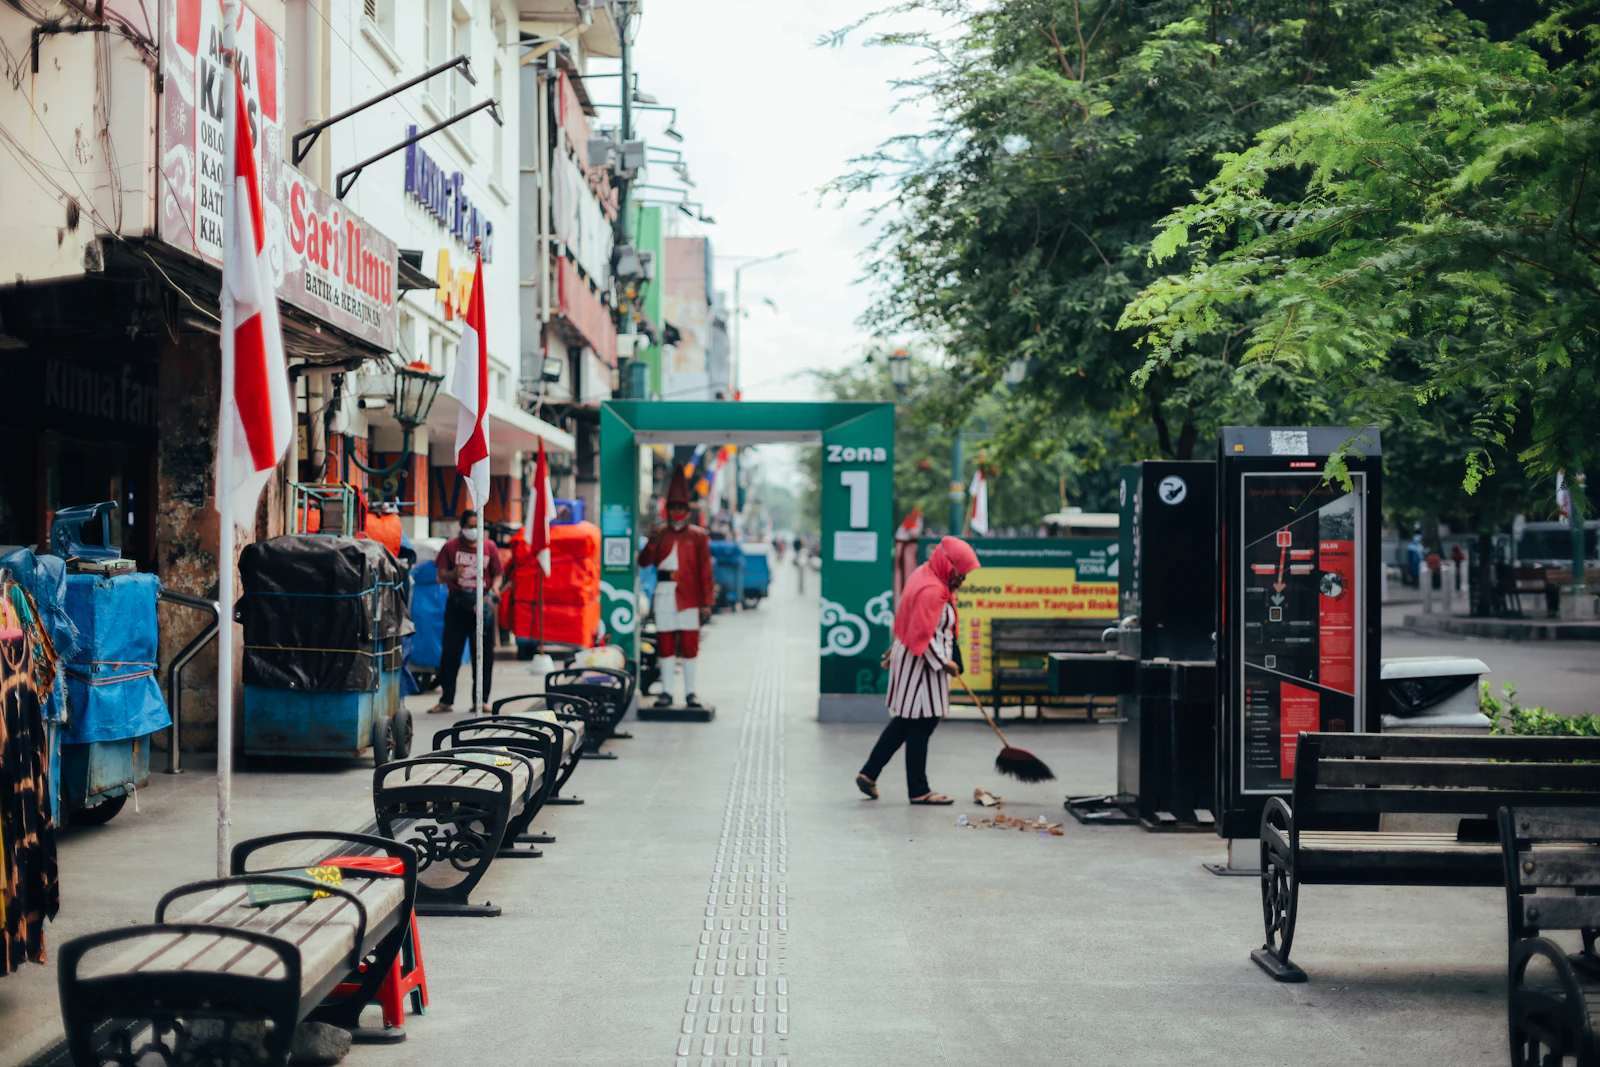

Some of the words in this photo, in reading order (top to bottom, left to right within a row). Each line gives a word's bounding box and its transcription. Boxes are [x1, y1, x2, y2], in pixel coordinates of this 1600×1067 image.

[201, 120, 224, 155] OBLO
[201, 151, 224, 186] KAO
[201, 183, 224, 218] BATI
[201, 215, 224, 249] KHA
[290, 181, 339, 277] Sari
[346, 219, 392, 307] Ilmu
[305, 272, 333, 303] BATIK
[334, 287, 339, 305] &
[341, 290, 381, 328] KERAJINAN
[827, 444, 887, 462] Zona
[841, 471, 869, 528] 1
[957, 600, 973, 609] an
[976, 600, 1040, 610] Kawasan
[1042, 599, 1085, 612] Tanpa
[1004, 584, 1068, 596] Kawasan
[1071, 584, 1118, 596] Berma
